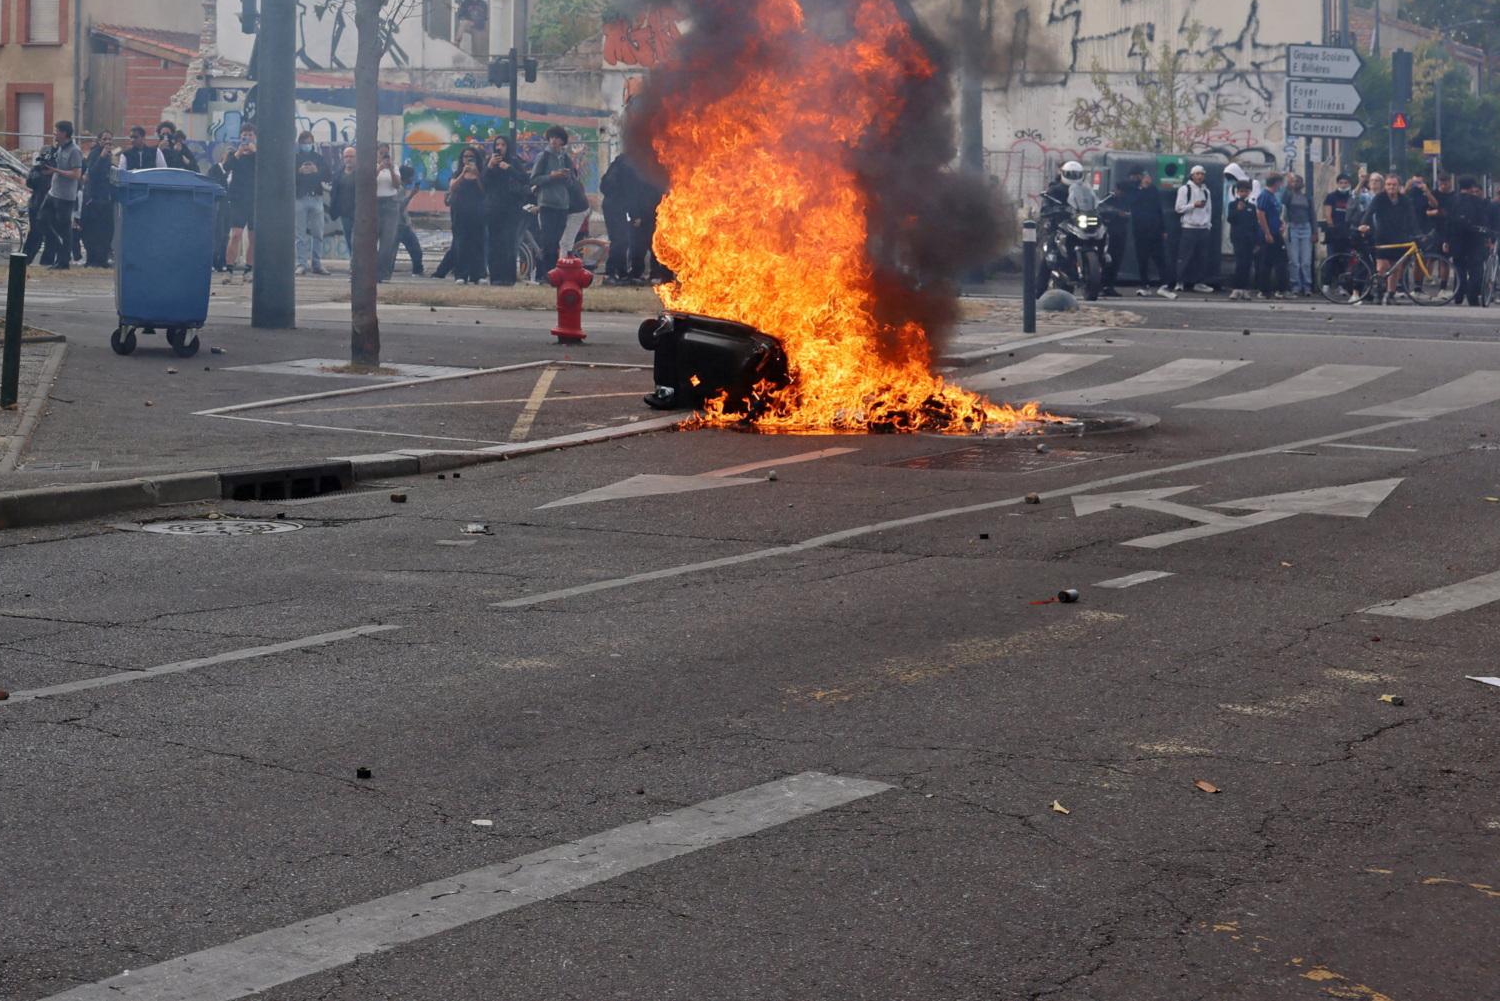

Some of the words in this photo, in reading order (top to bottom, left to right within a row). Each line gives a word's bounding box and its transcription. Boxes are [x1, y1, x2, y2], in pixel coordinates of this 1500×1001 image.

[1293, 49, 1318, 62] Groupe
[1321, 51, 1350, 62] Scolaire
[1293, 86, 1317, 97] Foyer
[1293, 121, 1342, 133] Commerces
